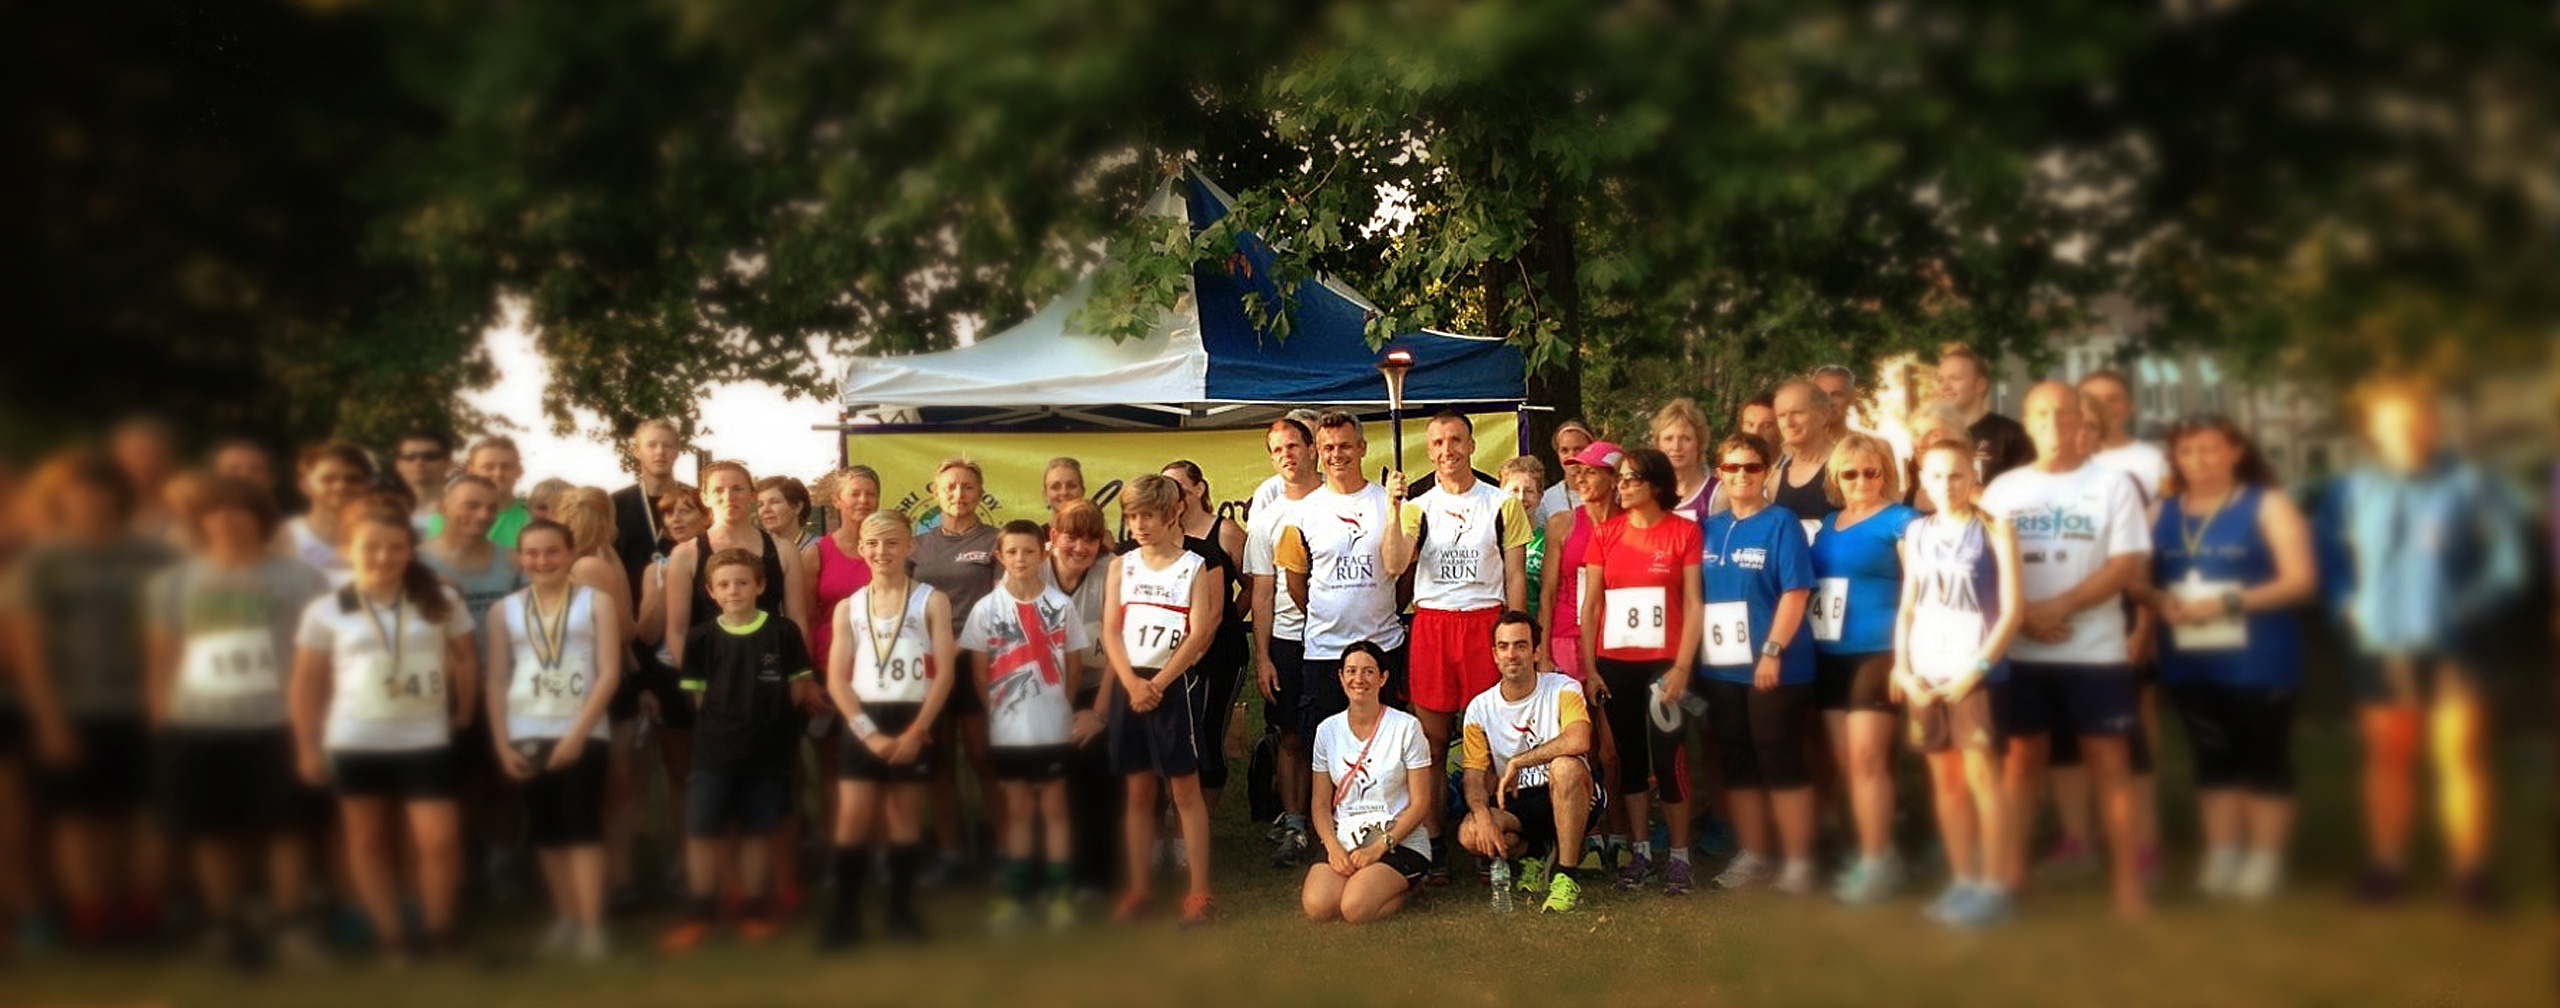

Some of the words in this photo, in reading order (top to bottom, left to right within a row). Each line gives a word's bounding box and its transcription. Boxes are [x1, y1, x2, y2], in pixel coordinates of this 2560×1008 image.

[1336, 554, 1374, 567] PEACE
[1440, 549, 1479, 559] WORLD
[1336, 564, 1373, 580] RUN
[1440, 565, 1478, 579] RUN
[1627, 607, 1640, 629] 8
[1653, 605, 1663, 628] B
[1832, 597, 1843, 619] B
[1139, 625, 1166, 648] 17
[1169, 629, 1182, 650] B
[1711, 624, 1723, 646] 6
[1736, 621, 1747, 643] B
[911, 657, 924, 681] C
[570, 672, 583, 697] C
